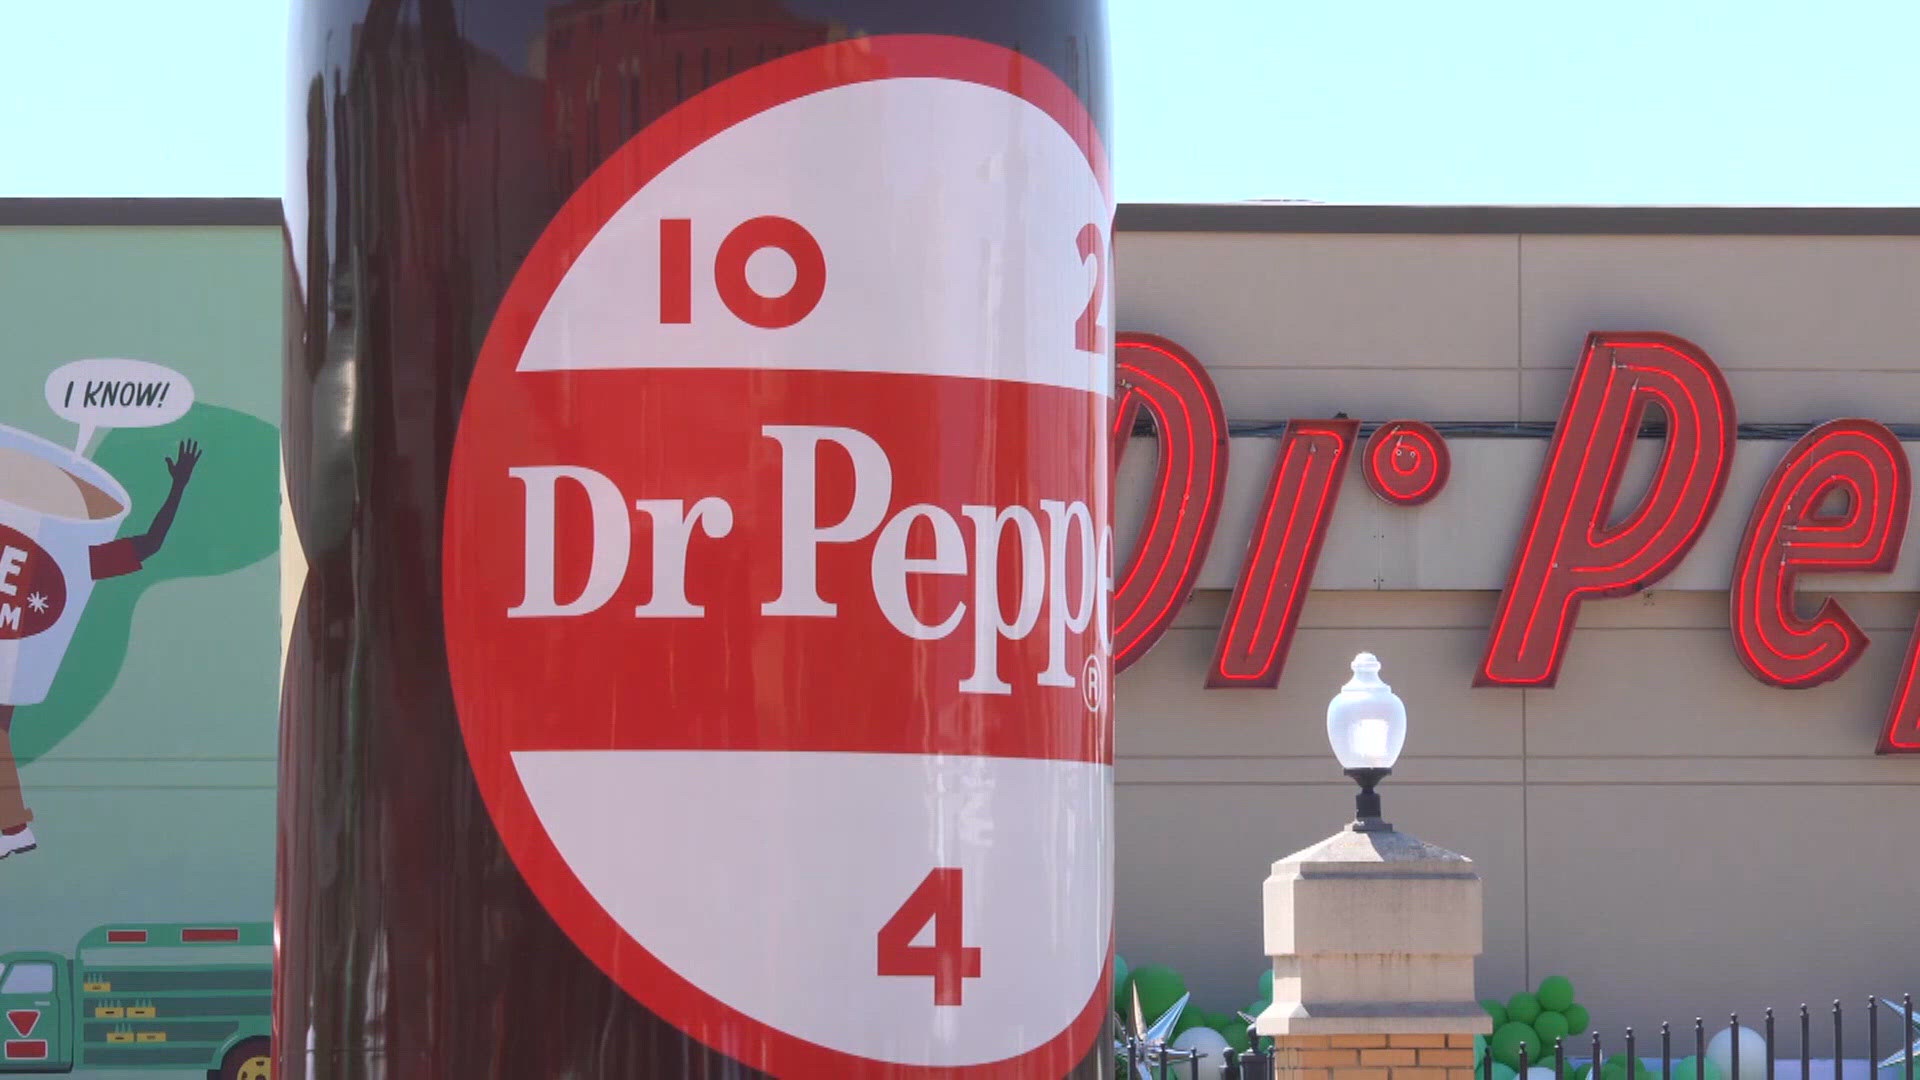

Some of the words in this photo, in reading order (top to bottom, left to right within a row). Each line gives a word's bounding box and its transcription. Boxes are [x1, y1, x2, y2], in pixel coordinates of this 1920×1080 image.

[660, 215, 826, 329] 10
[1075, 223, 1106, 355] 2
[64, 381, 74, 408] I
[83, 381, 170, 408] KNOW!
[507, 465, 734, 618] Dr
[1471, 331, 1920, 754] Pe
[877, 867, 981, 1006] 4
